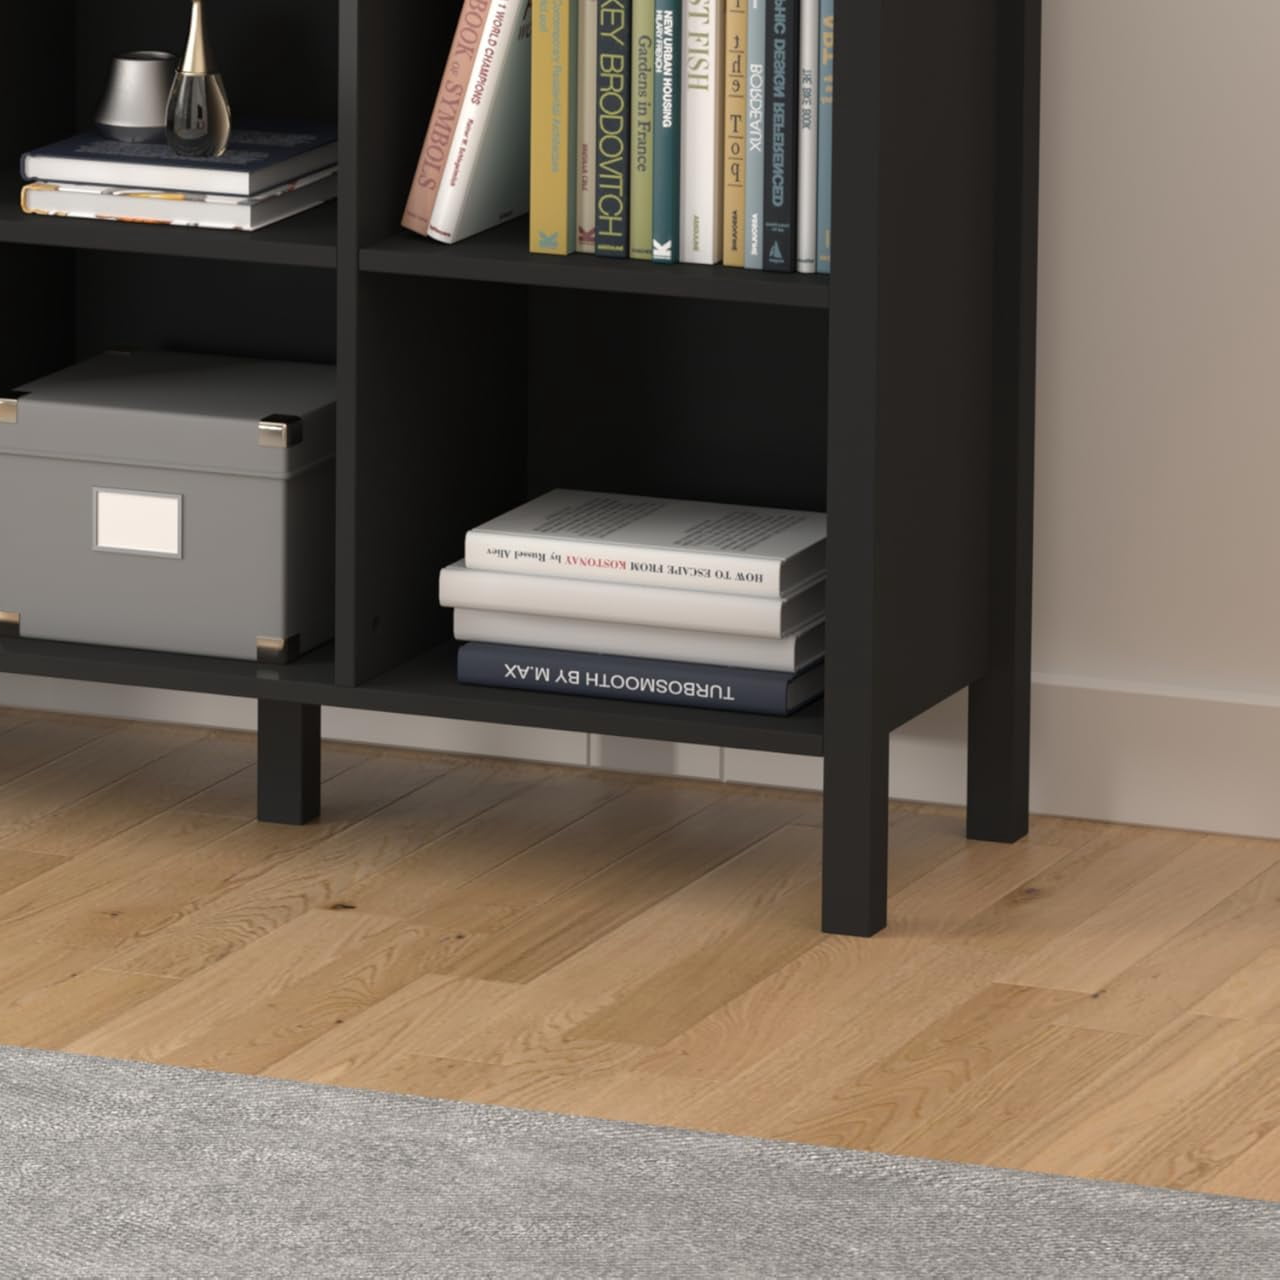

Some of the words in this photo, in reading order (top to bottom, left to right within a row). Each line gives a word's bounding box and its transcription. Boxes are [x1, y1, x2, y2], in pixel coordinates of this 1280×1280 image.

[487, 11, 508, 47] WORLD
[663, 10, 673, 35] NEW
[637, 35, 651, 97] Gardens
[663, 38, 673, 76] URBAN
[688, 32, 709, 92] FISH
[471, 47, 495, 105] CHAMPIONS
[638, 102, 650, 116] in
[662, 78, 672, 127] HOUSING
[419, 79, 463, 190] SYMBOLS
[599, 54, 624, 236] BRODOVITCH
[637, 122, 650, 172] France
[514, 549, 546, 562] Russel
[550, 552, 562, 563] by
[565, 555, 627, 570] KOSTONAY
[630, 561, 663, 574] FROM
[667, 564, 711, 578] ESCAPE
[714, 569, 731, 581] TO
[735, 571, 764, 583] HOW
[504, 663, 550, 683] M.AX
[555, 669, 579, 684] BY
[585, 671, 735, 701] TURBOSMOOTH
